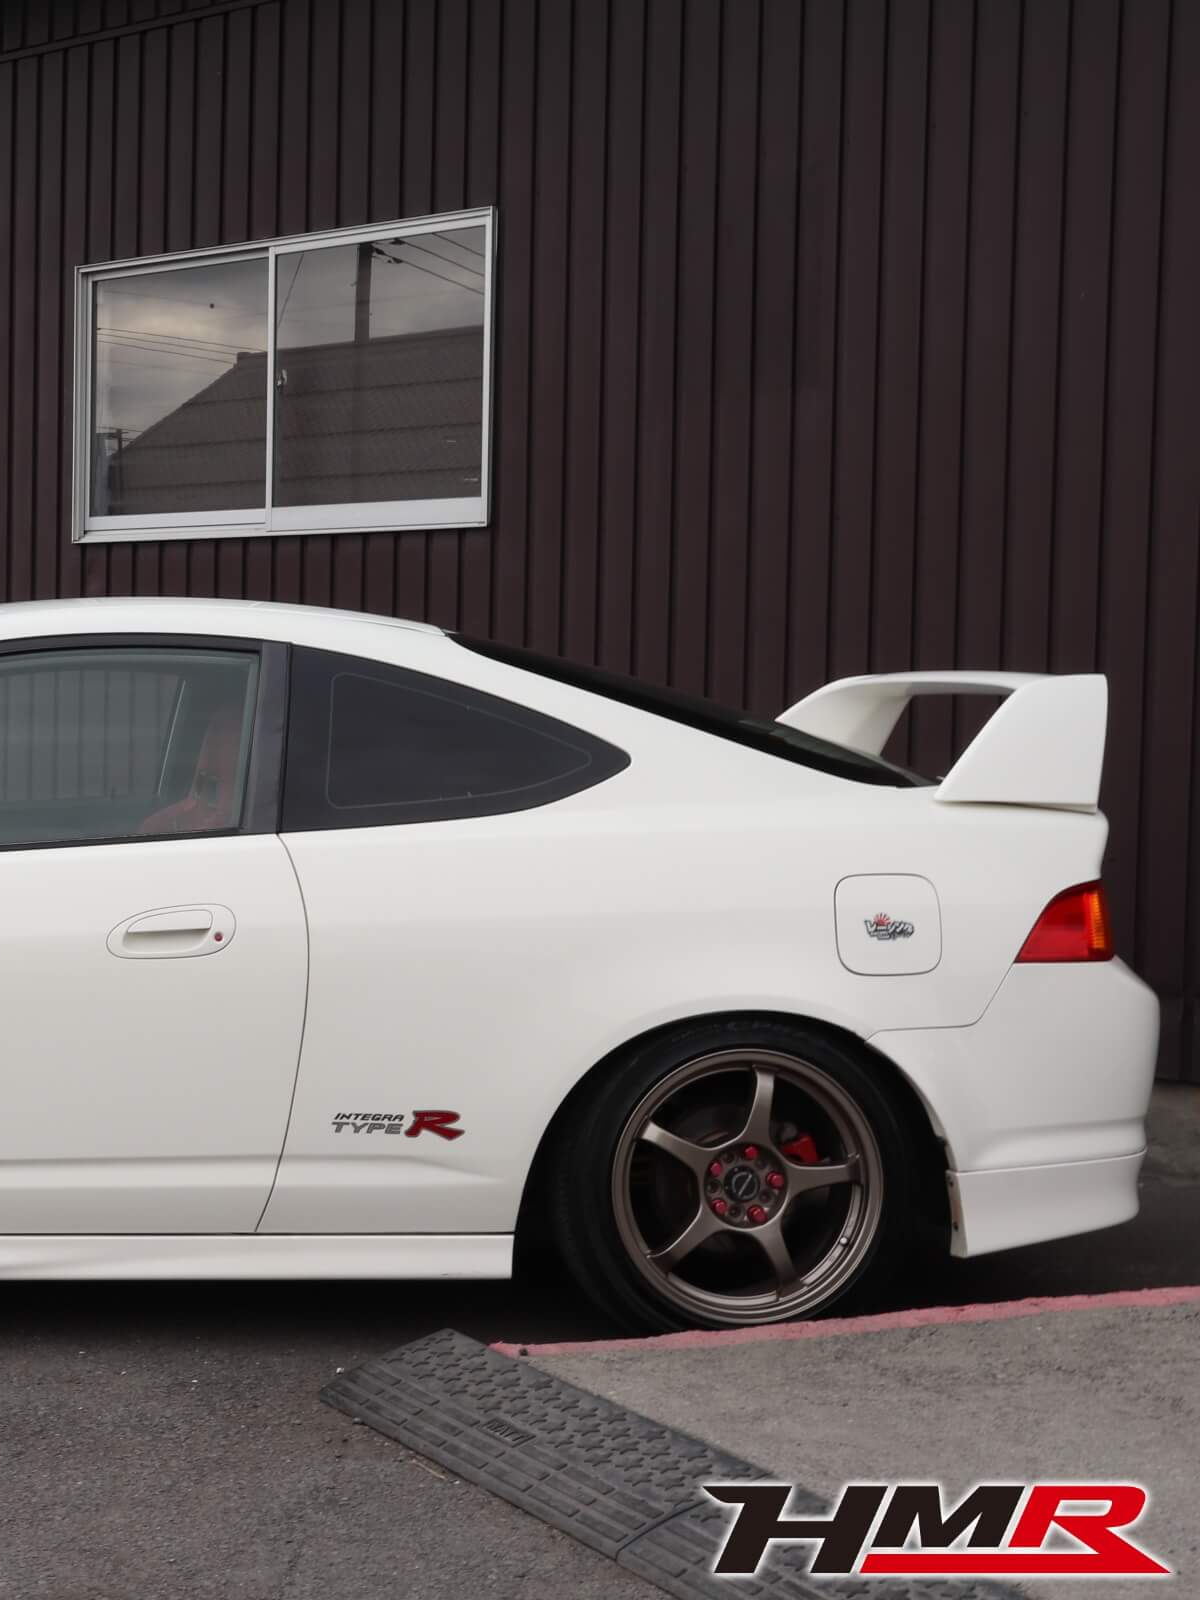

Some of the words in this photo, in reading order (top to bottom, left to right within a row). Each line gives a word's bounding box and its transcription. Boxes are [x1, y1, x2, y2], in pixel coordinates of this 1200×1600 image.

[331, 1122, 404, 1135] TYPE
[404, 1109, 465, 1141] R
[333, 1112, 405, 1122] INTEGRA
